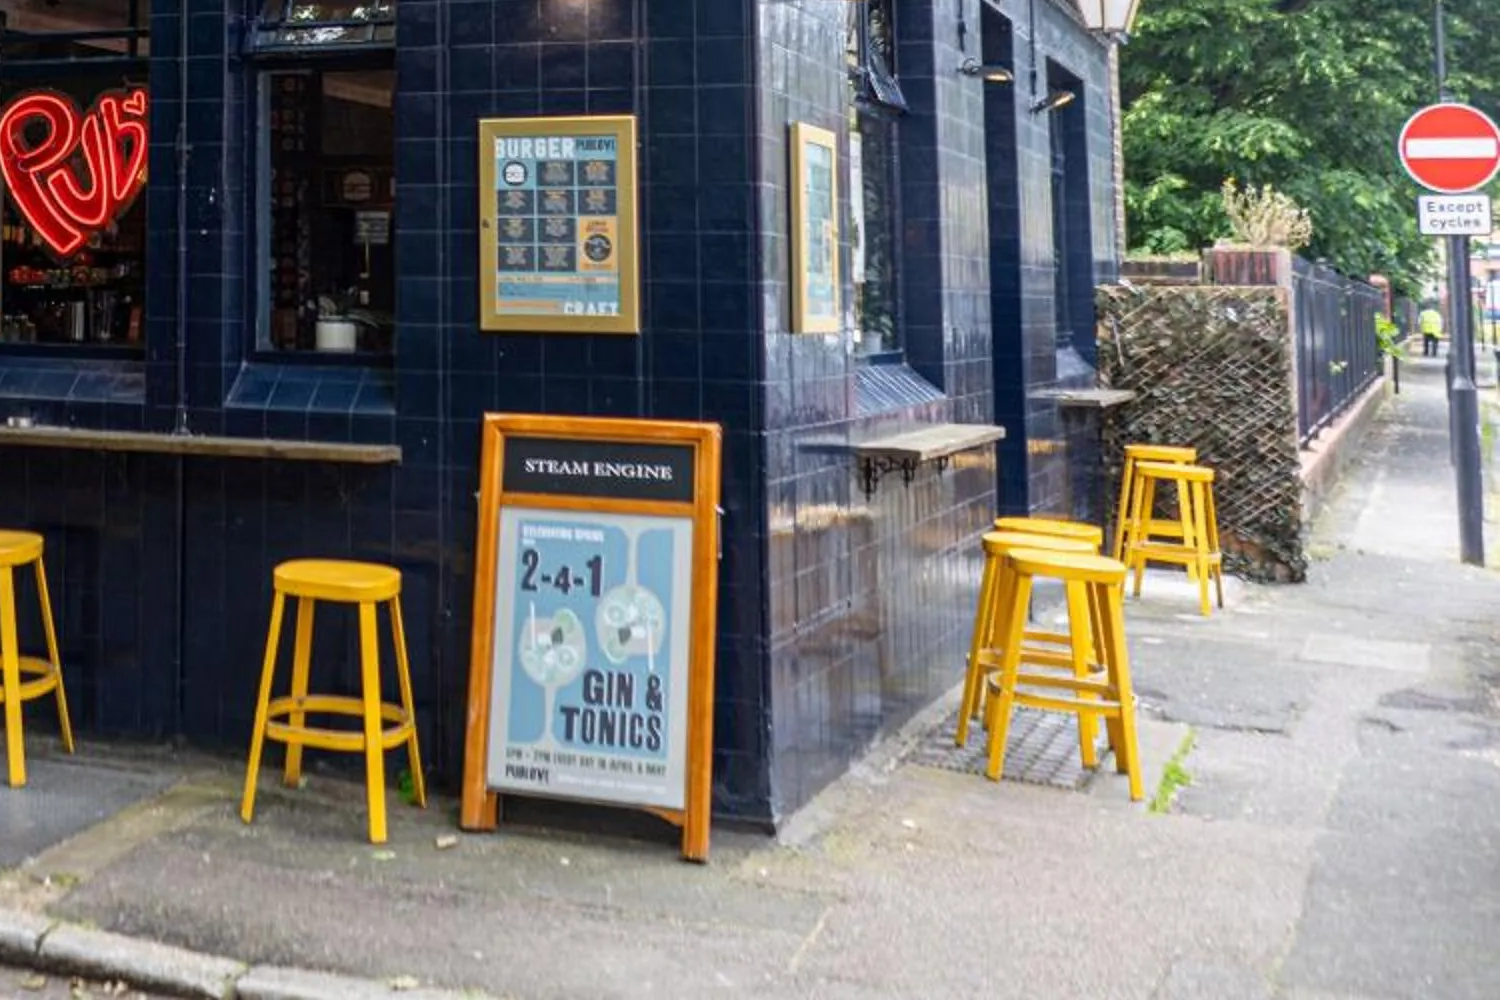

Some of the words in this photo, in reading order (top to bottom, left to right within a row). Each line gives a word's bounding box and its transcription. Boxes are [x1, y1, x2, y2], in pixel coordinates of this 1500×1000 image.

[495, 137, 576, 159] BURGER
[1426, 201, 1483, 213] Except
[1429, 216, 1481, 231] cycles
[563, 301, 619, 316] CRAFT
[524, 458, 590, 476] STEAM
[594, 462, 673, 481] ENGINE
[520, 548, 603, 597] 2-4-1
[582, 669, 633, 709] GIN
[645, 674, 663, 713] &
[560, 705, 662, 752] TONICS
